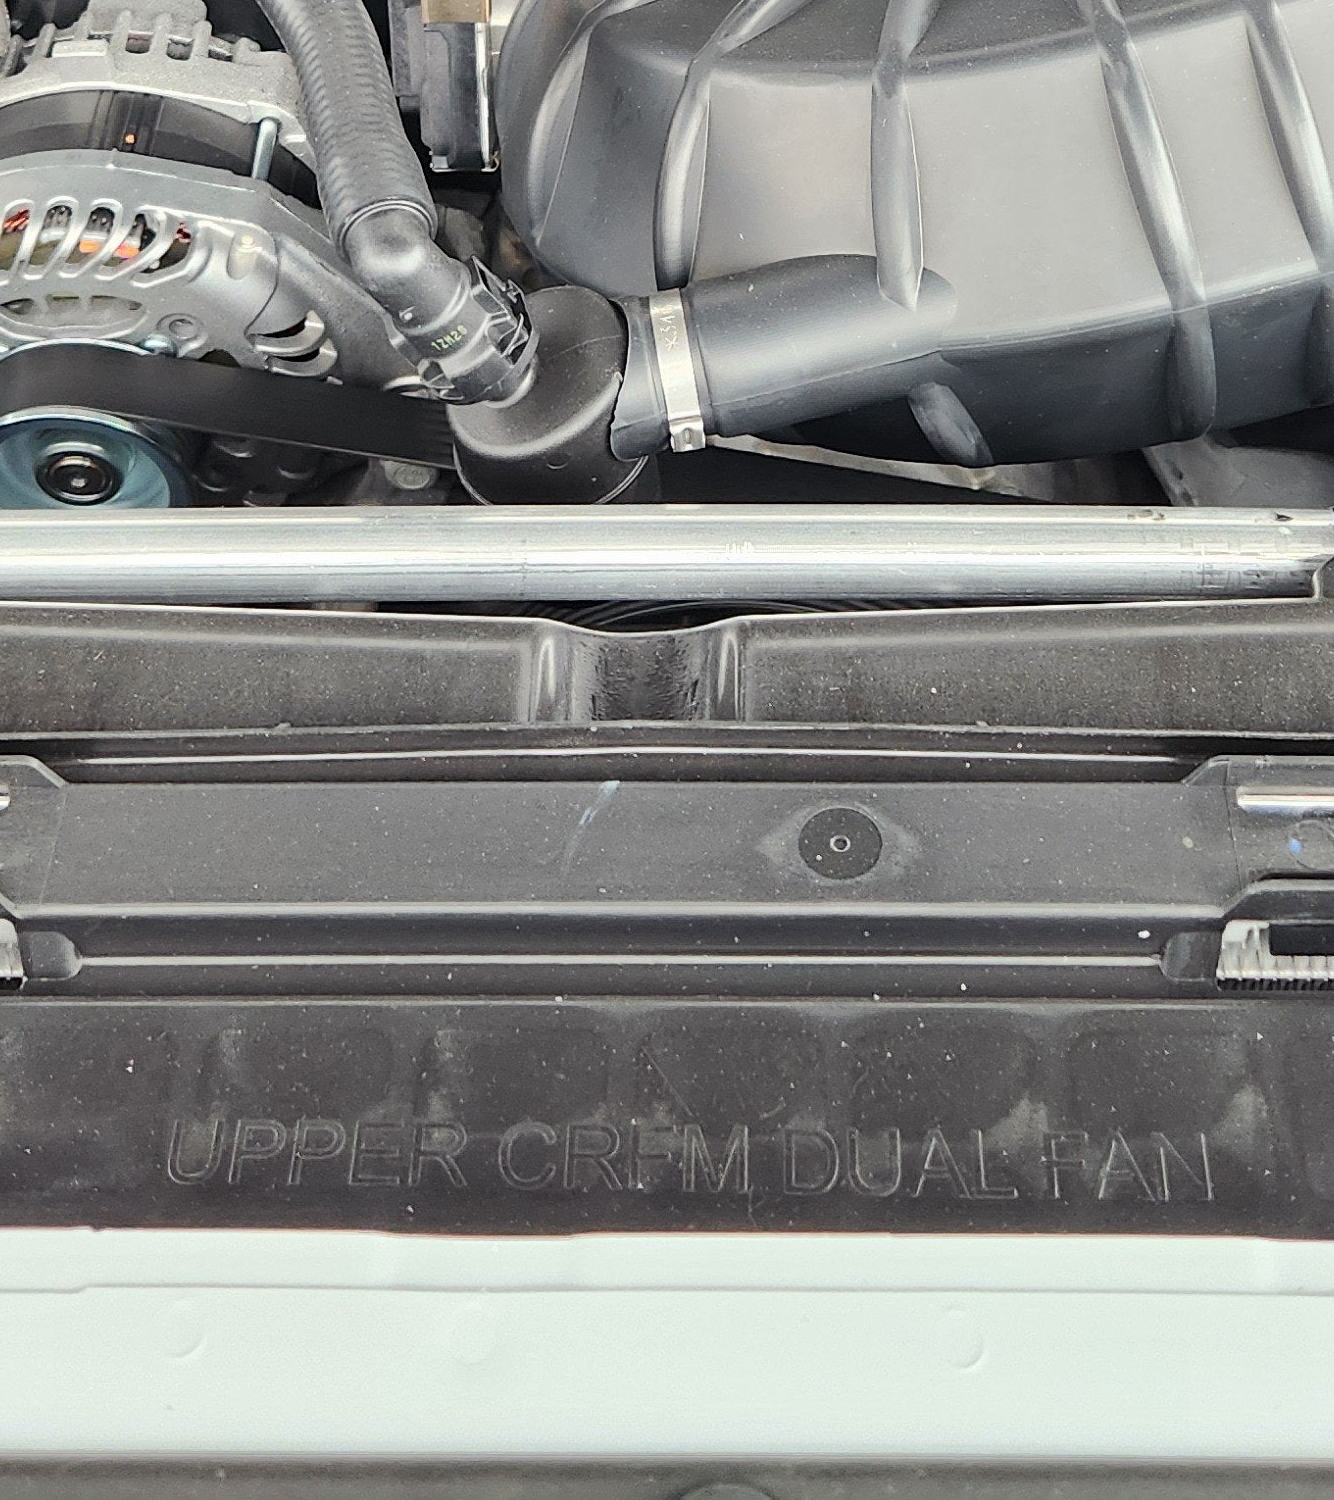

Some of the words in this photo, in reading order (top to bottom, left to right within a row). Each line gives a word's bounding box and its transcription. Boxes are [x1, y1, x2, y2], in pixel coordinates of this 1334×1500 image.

[167, 1117, 468, 1187] UPPER
[498, 1120, 750, 1194] CRFM
[781, 1126, 1019, 1199] DUAL
[1042, 1130, 1214, 1202] FAN
